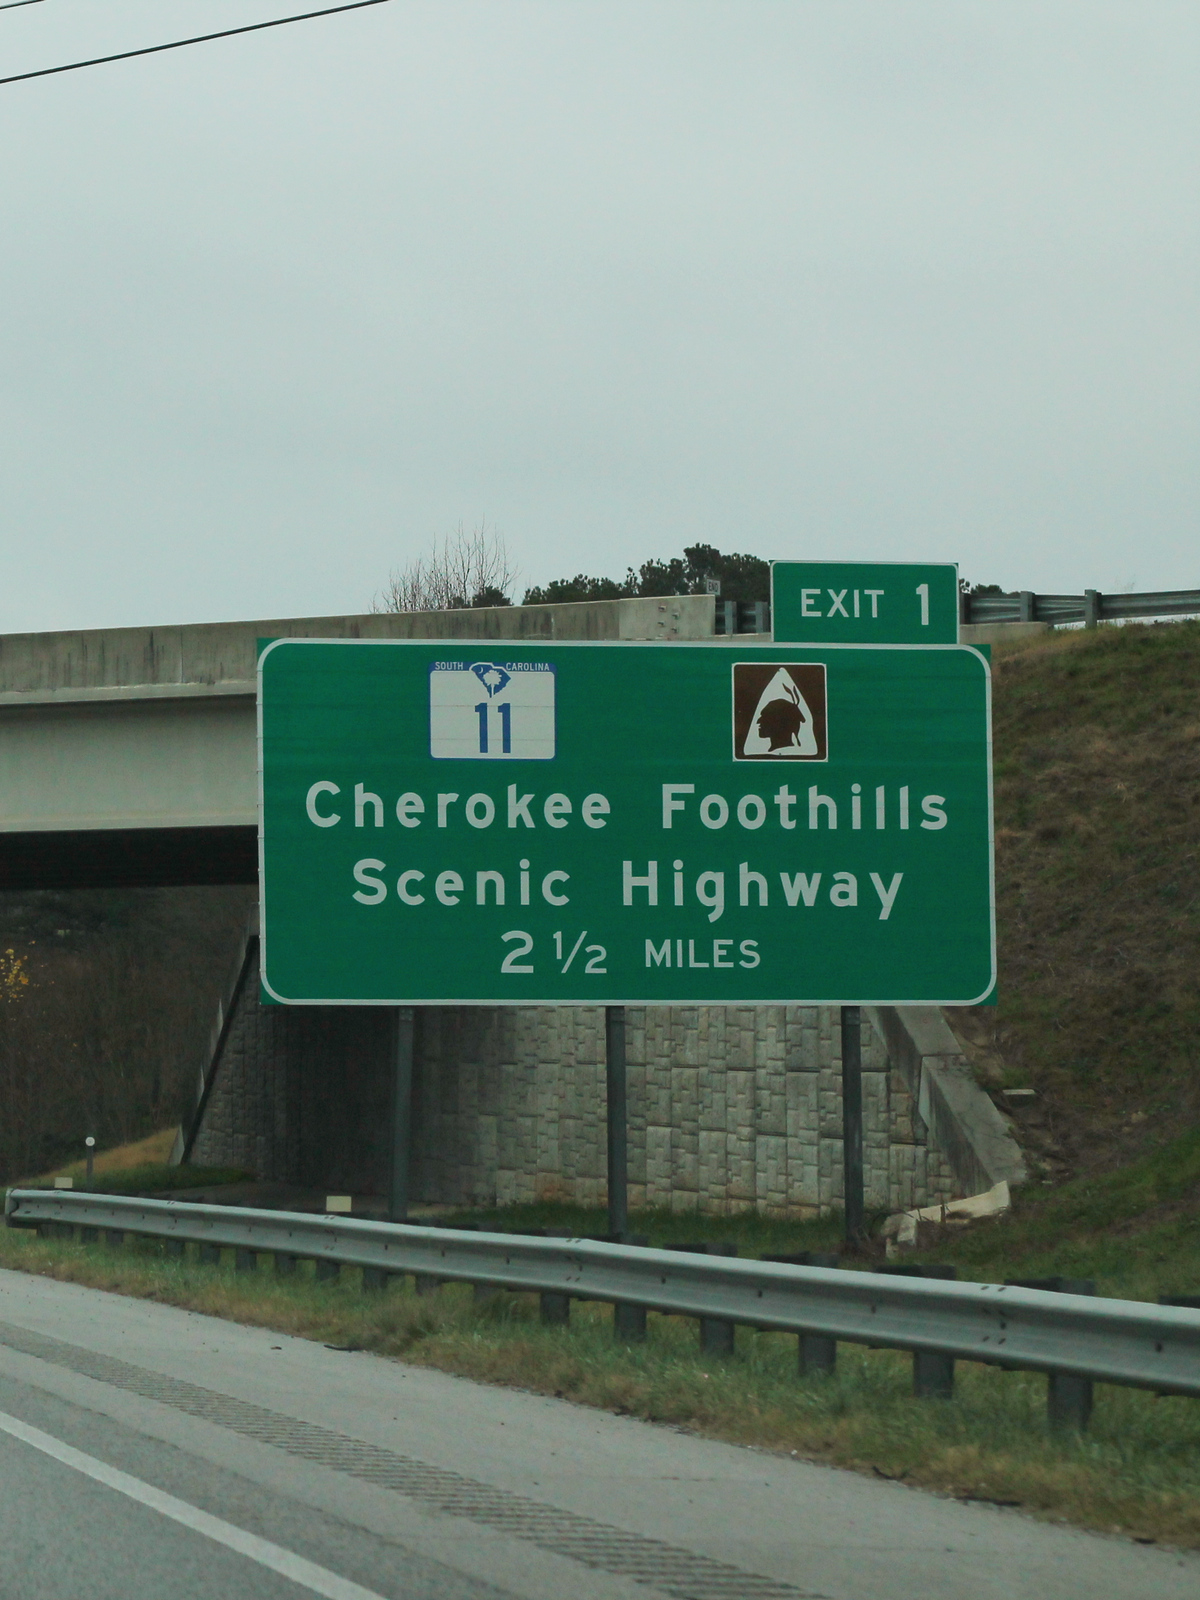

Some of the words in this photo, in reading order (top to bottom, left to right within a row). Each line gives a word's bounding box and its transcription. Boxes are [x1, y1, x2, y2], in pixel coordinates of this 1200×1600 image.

[801, 588, 885, 618] EXIT
[915, 584, 929, 626] 1
[435, 661, 464, 670] SOUTH
[506, 662, 550, 671] CAROLINA
[474, 702, 511, 754] 11
[305, 780, 611, 829] Cherokee
[662, 783, 948, 830] Foothills
[352, 858, 570, 906] Scenic
[622, 859, 904, 923] Highway
[500, 930, 534, 974] 2
[645, 939, 761, 969] MILES
